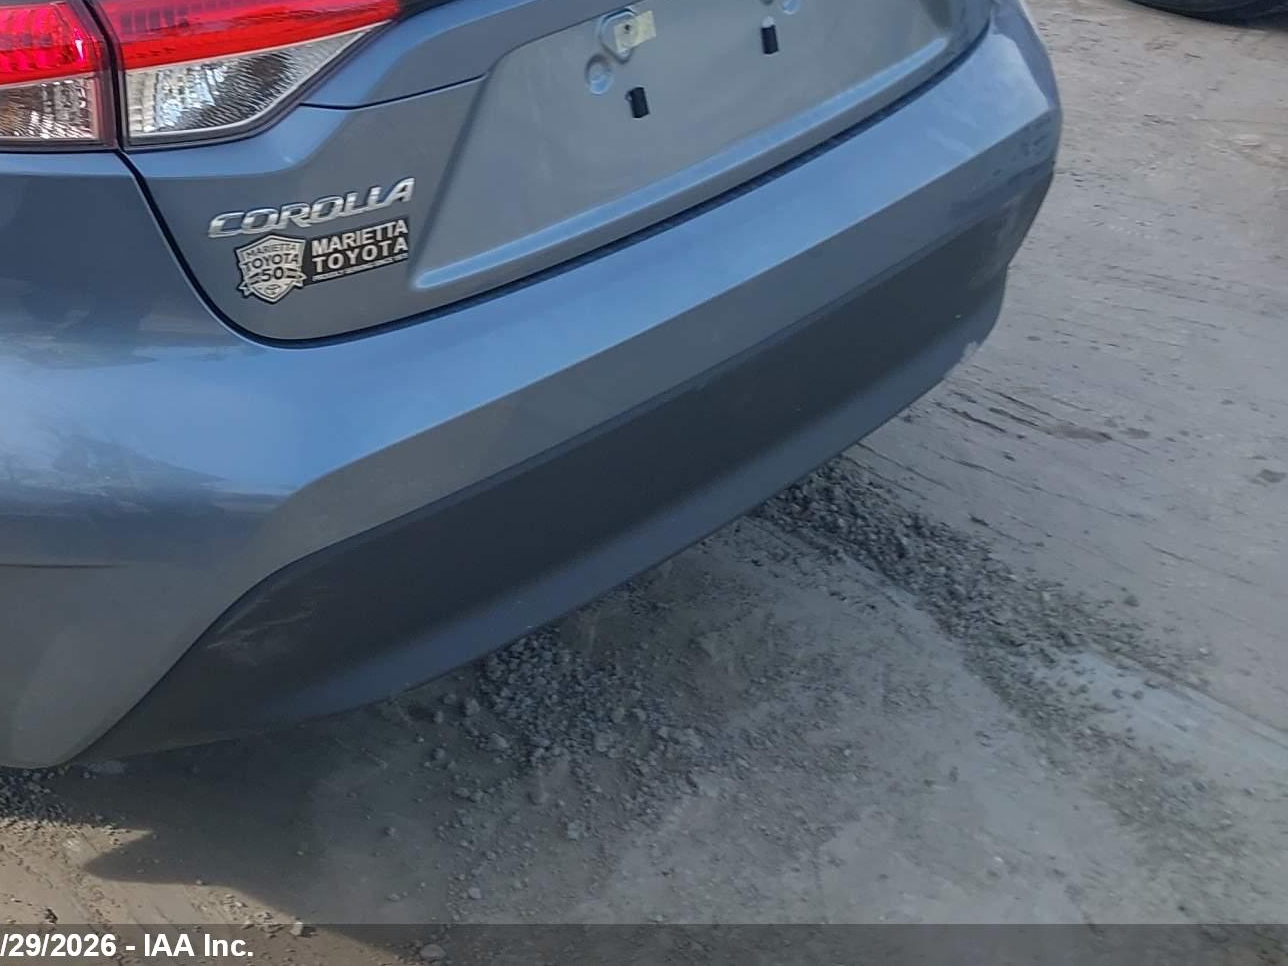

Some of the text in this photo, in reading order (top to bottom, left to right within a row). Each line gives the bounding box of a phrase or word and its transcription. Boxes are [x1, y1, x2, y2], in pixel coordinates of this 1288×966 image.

[208, 177, 415, 238] COROLLA
[312, 219, 409, 256] MARIETTA
[312, 237, 409, 273] TOYOTA
[242, 253, 299, 272] TOYOTA
[261, 266, 284, 282] 50
